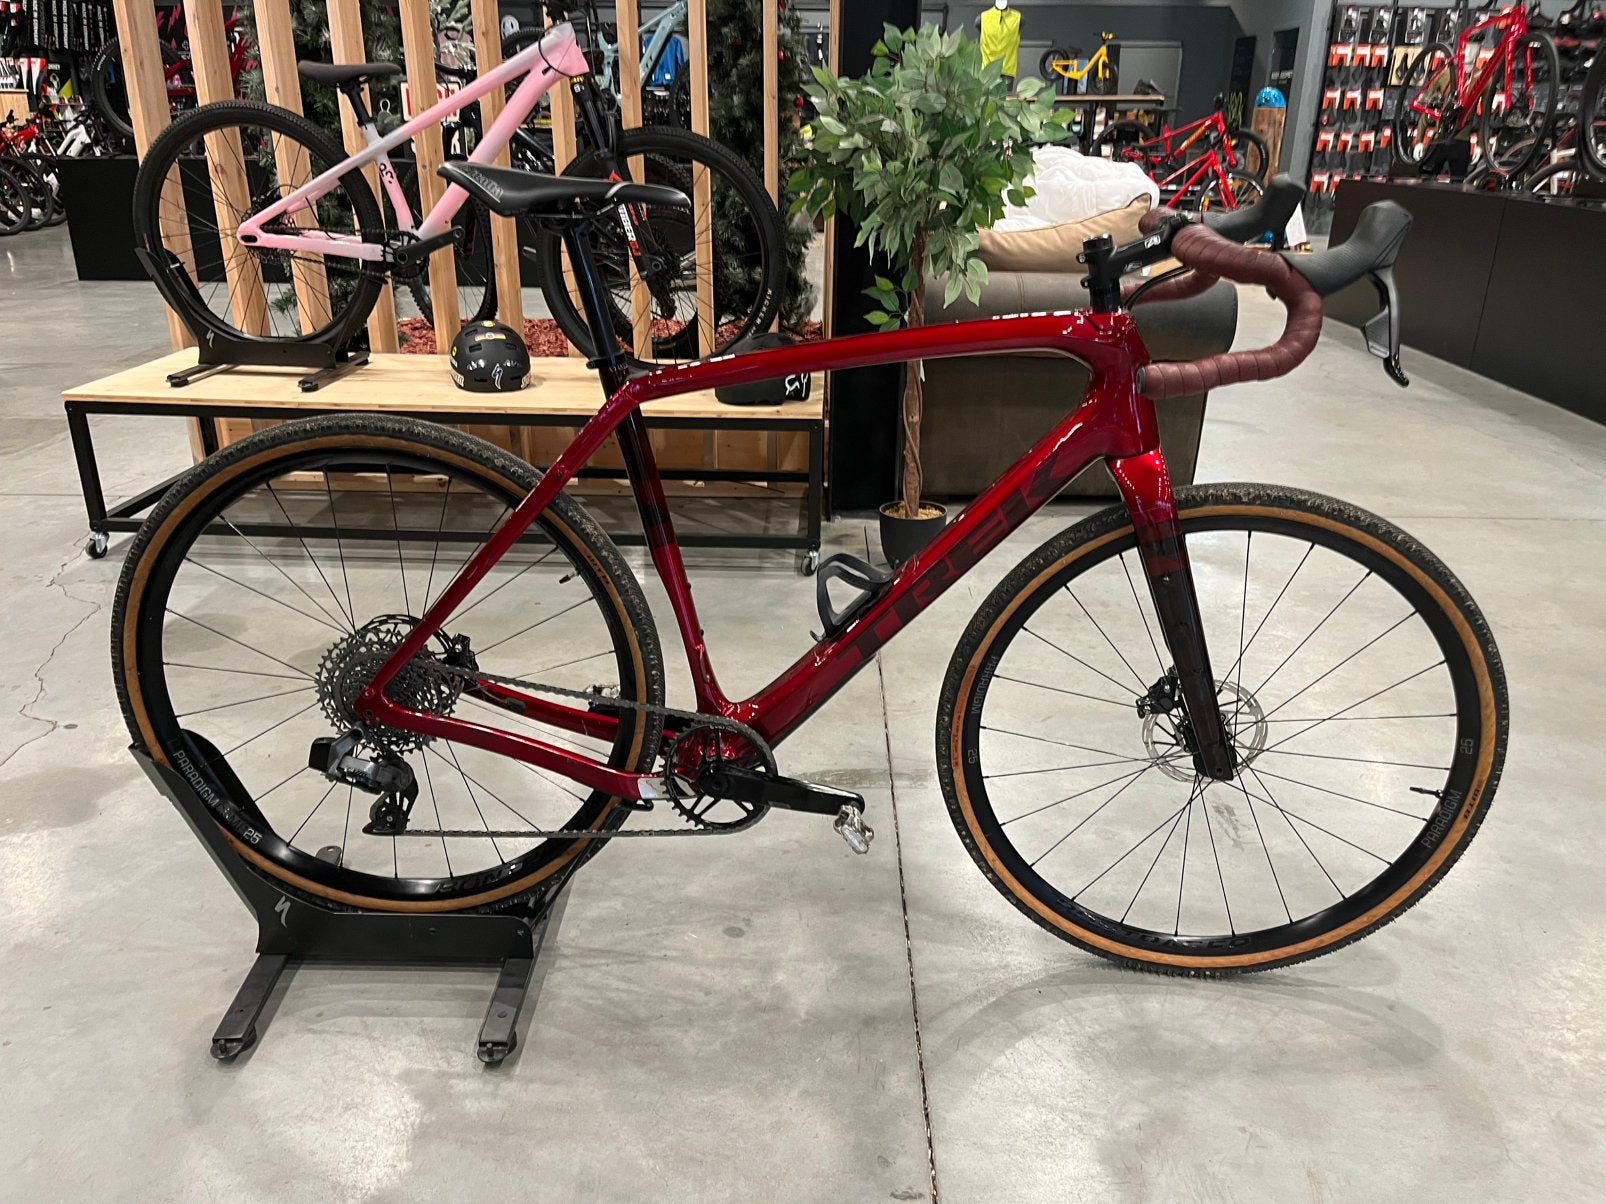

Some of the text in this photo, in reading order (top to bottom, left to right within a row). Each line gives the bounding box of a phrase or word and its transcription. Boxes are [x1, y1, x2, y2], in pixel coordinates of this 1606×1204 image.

[837, 451, 1069, 661] TREK
[967, 655, 1000, 765] PARADIGM 25
[173, 750, 220, 808] PARADIGM
[243, 826, 263, 845] 25
[1421, 738, 1474, 849] PARADIGM 25
